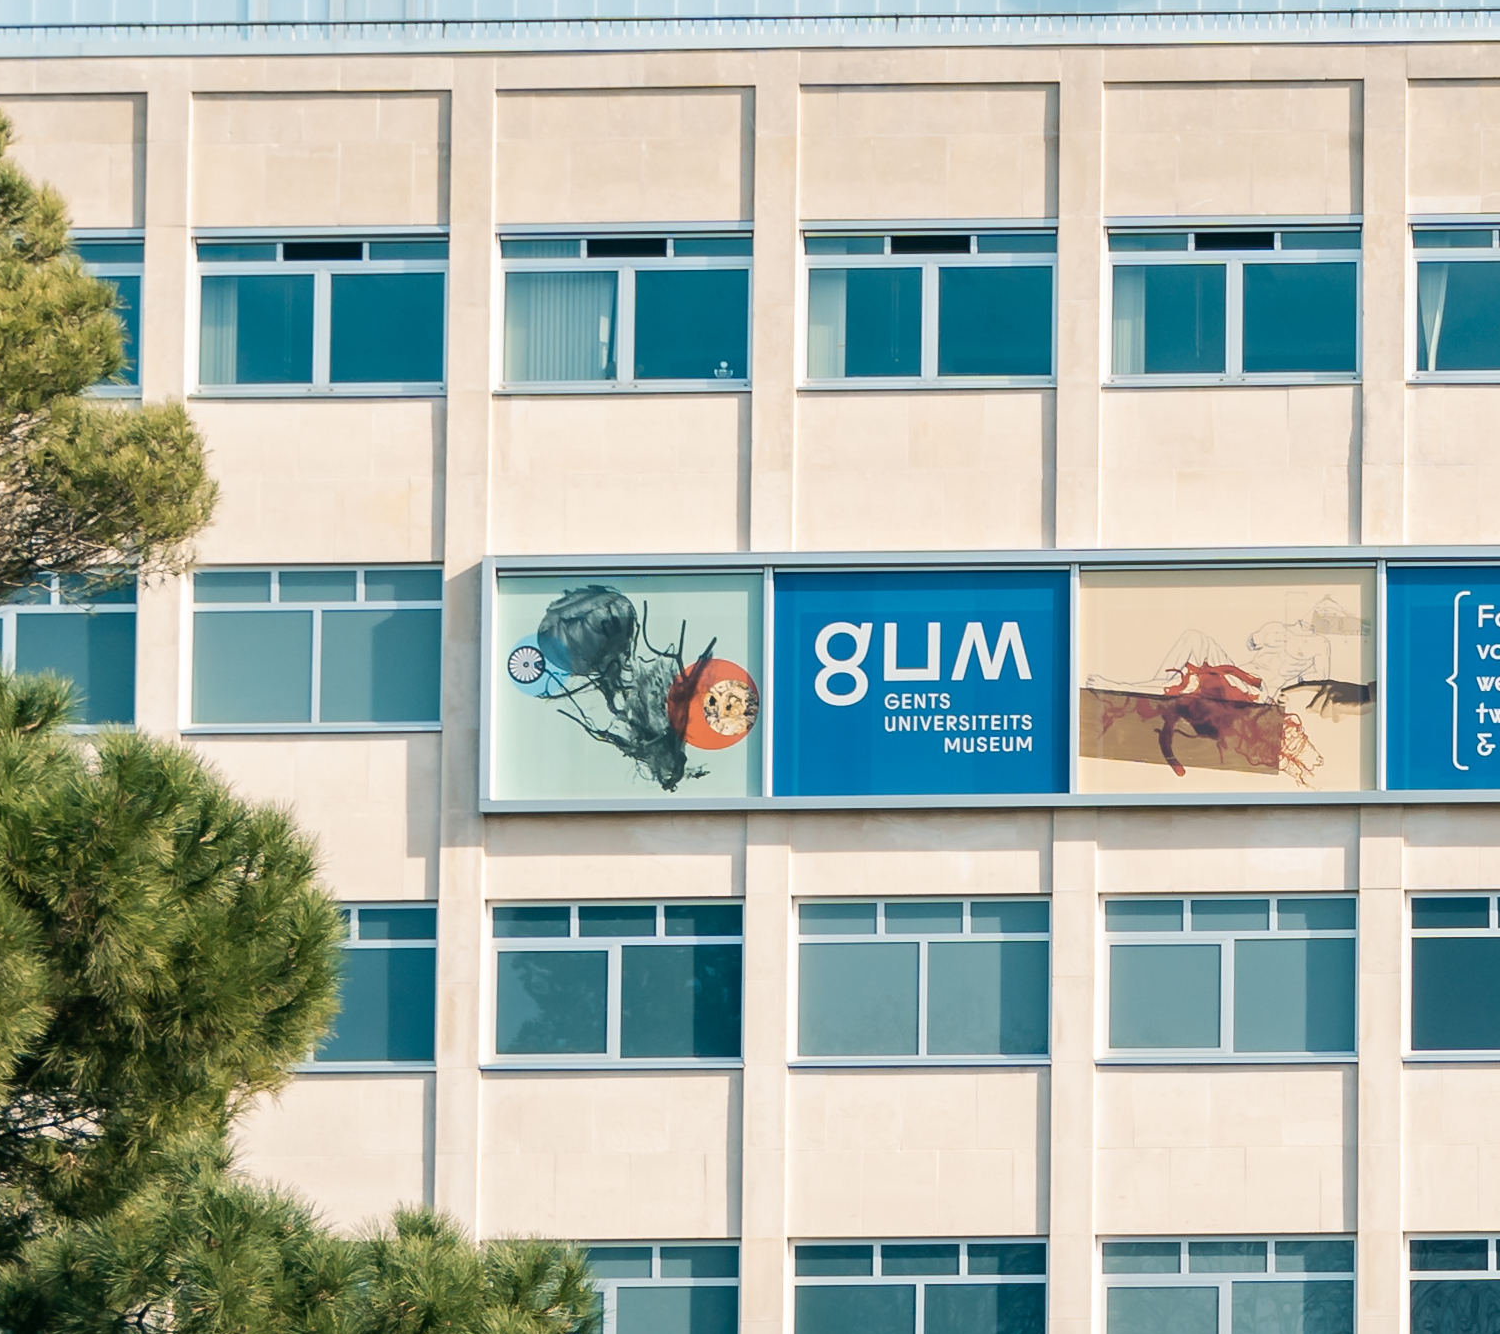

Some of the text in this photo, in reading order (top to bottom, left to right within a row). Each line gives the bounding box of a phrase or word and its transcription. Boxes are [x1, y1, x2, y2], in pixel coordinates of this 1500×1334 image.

[884, 692, 951, 710] GENTS
[884, 714, 1033, 733] UNIVERSITEITS
[944, 736, 1033, 754] MUSEUM
[1476, 732, 1496, 757] &
